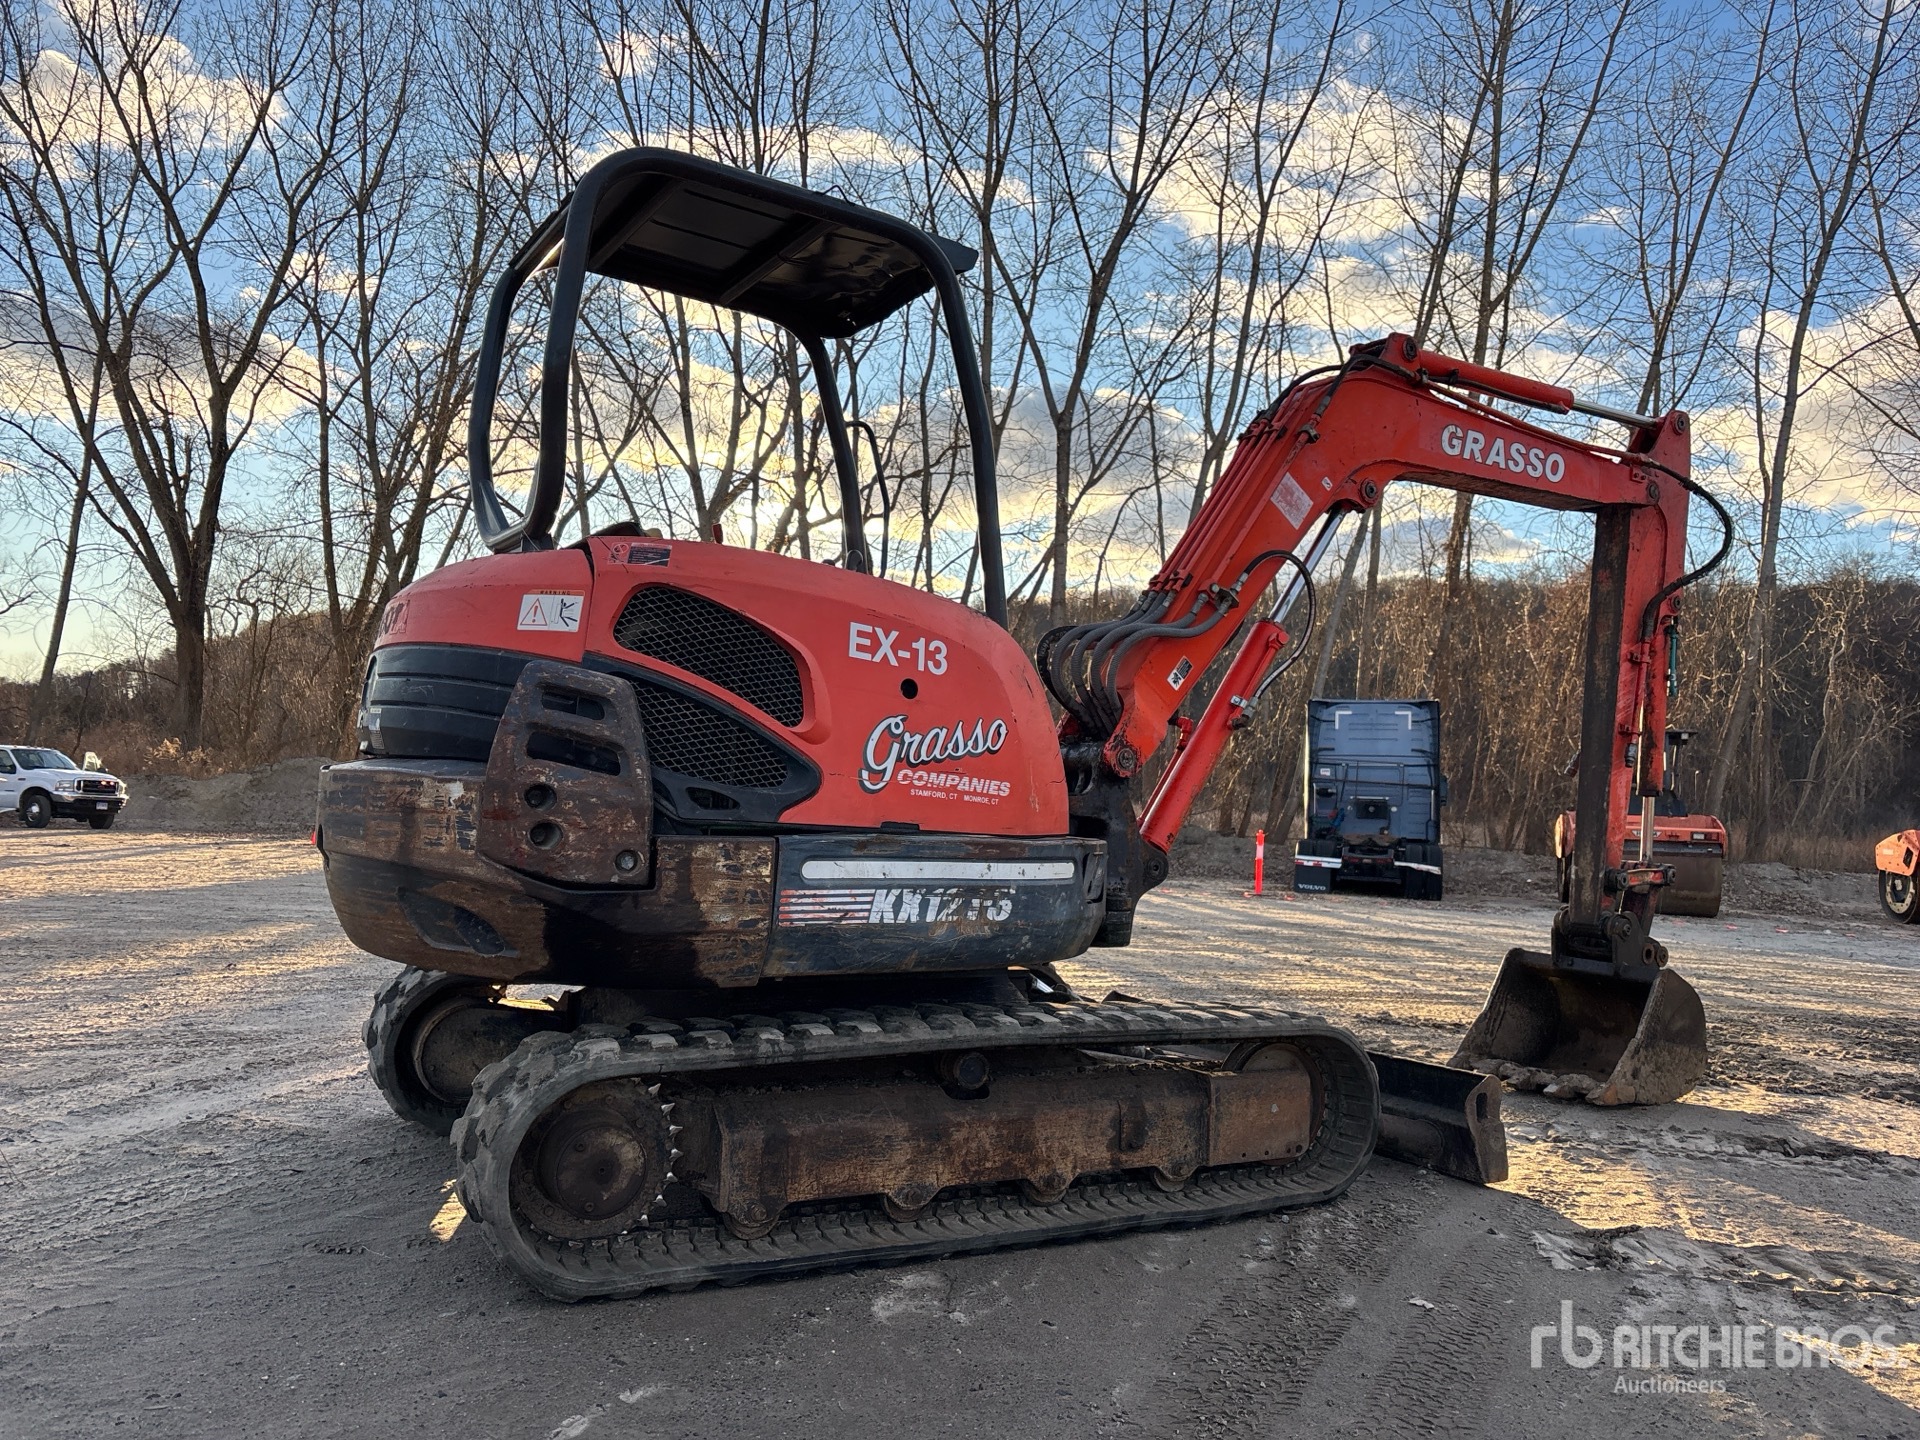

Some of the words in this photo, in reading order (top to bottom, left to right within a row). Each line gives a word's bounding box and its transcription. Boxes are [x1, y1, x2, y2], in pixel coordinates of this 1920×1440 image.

[1441, 424, 1565, 483] GRASSO
[848, 622, 948, 675] EX-13
[859, 715, 1008, 792] Grasso
[897, 769, 1011, 797] COMPANIES
[910, 788, 948, 800] STAMFORD,
[963, 794, 990, 805] MONROE,
[1298, 883, 1326, 891] VOLVO
